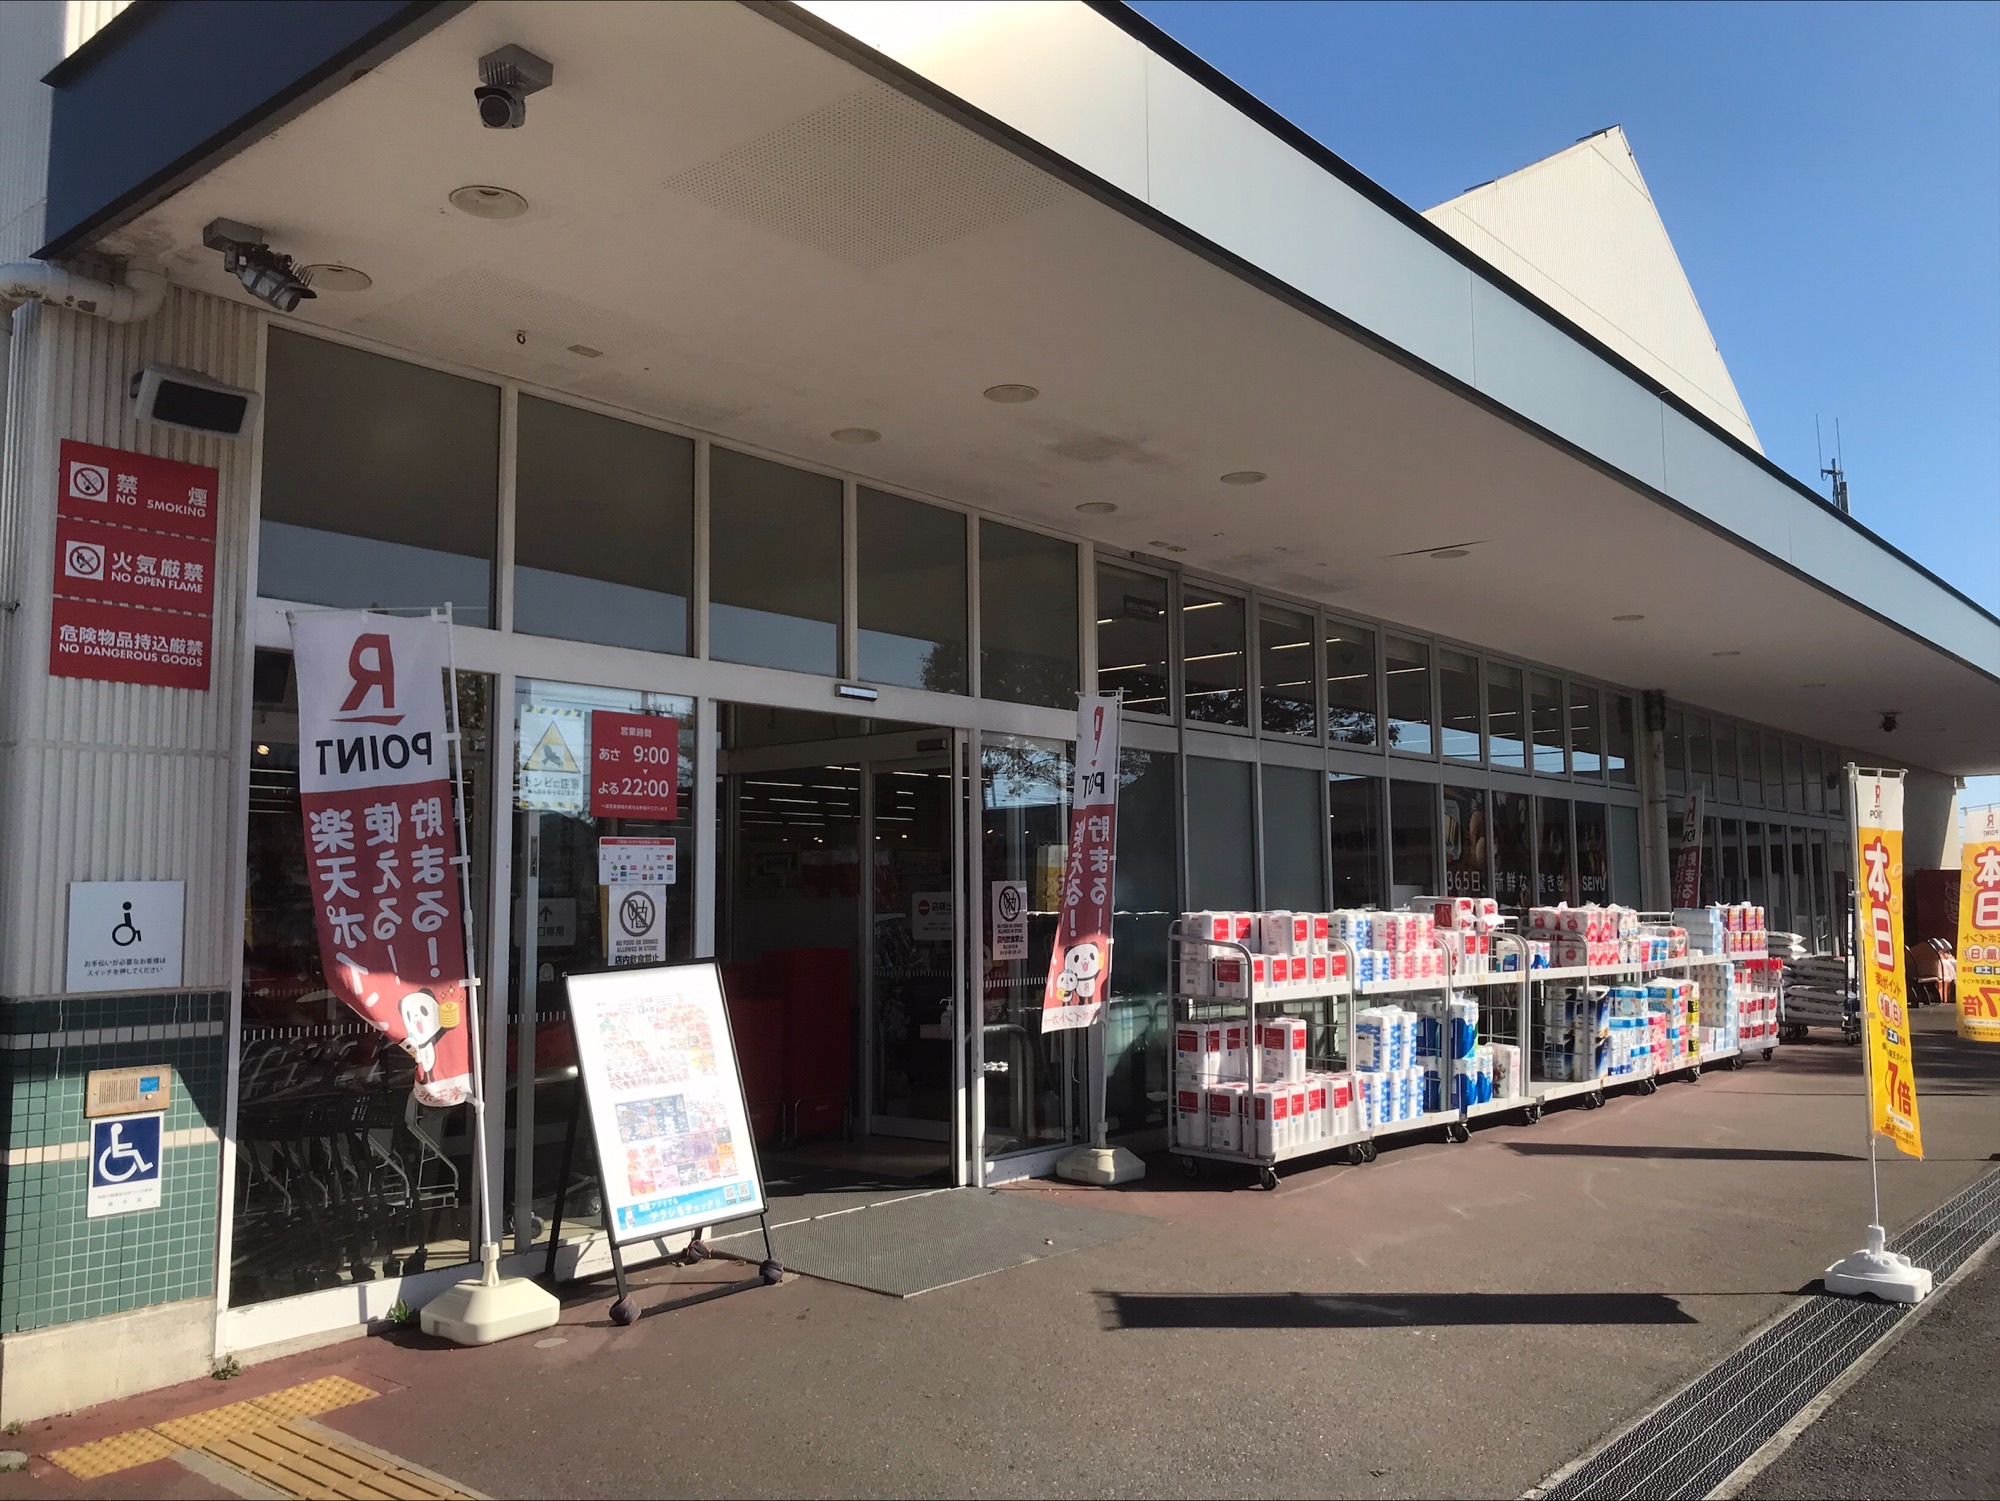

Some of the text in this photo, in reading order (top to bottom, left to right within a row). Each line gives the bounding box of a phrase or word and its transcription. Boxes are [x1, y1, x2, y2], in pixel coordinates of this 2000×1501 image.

[115, 493, 207, 518] NO SMOKING
[112, 551, 204, 583] 火気厳禁
[111, 571, 203, 593] NO OPEN FLAME
[59, 624, 204, 656] 危険物品持込厳禁
[59, 643, 203, 667] NO DANGEROUS GOODS
[620, 726, 653, 738] 営業時間
[599, 745, 670, 765] あさ 9:00
[598, 777, 669, 798] よる 22:00
[1582, 875, 1606, 892] SEIYU
[1864, 836, 1895, 972] 本日
[538, 926, 565, 936] 口専用
[87, 967, 163, 977] スイッチを押してください
